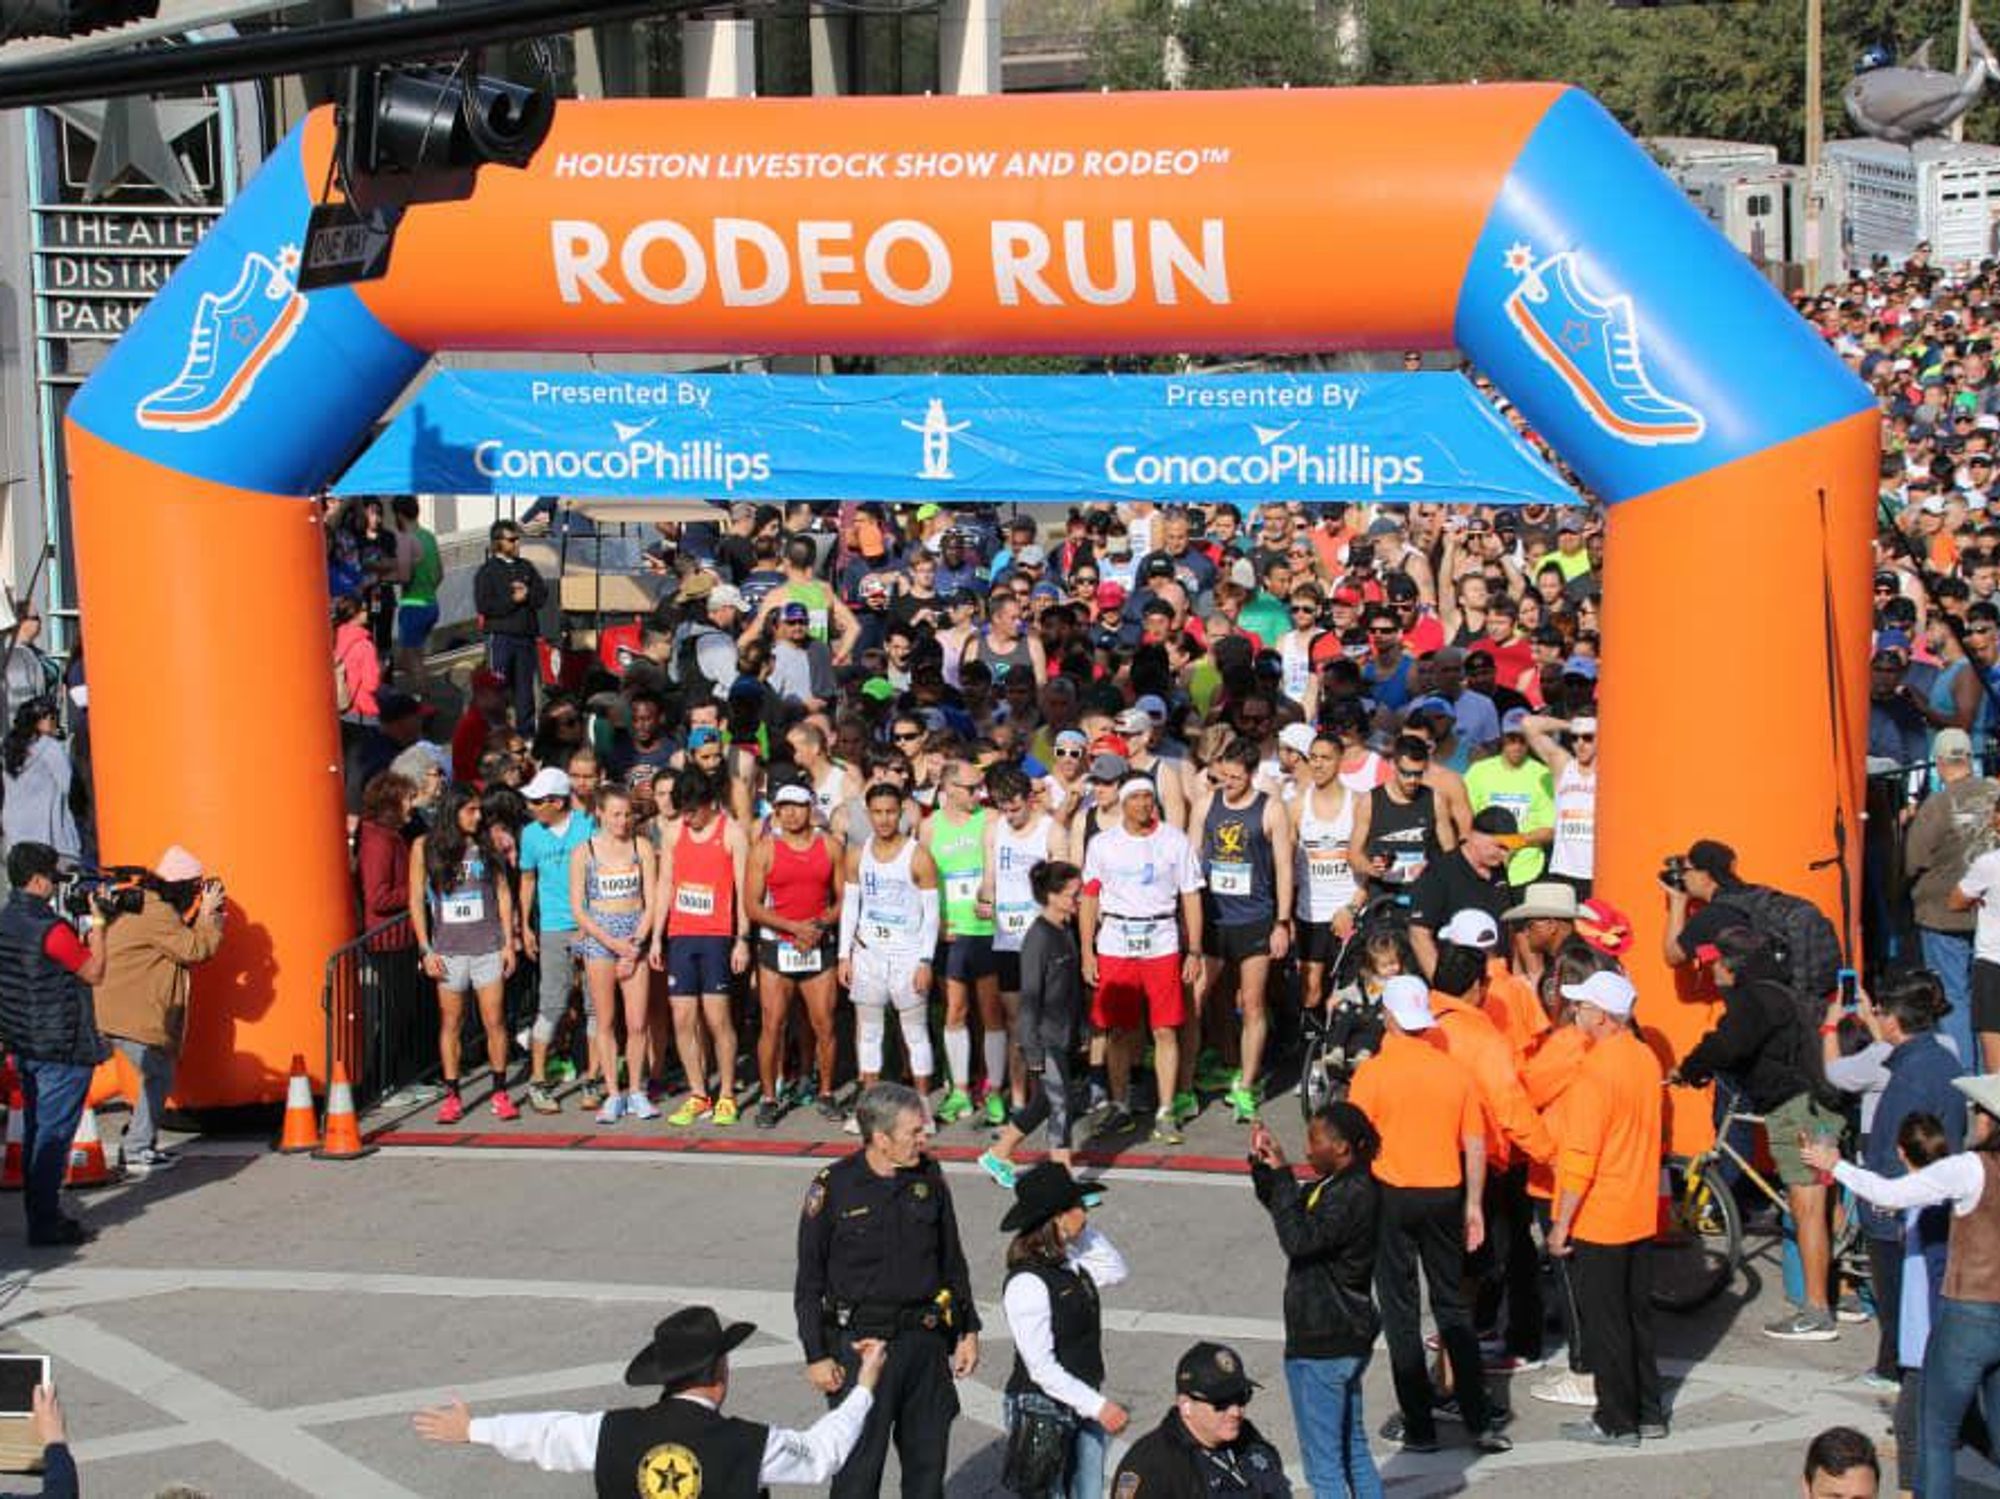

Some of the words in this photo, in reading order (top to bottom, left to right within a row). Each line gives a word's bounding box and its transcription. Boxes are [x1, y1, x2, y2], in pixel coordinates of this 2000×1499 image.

[555, 153, 711, 179] HOUSTON
[716, 152, 888, 179] LIVESTOCK
[894, 151, 999, 178] SHOW
[1002, 150, 1076, 177] AND
[551, 217, 953, 307] RODEO
[990, 218, 1230, 305] RUN
[532, 381, 668, 405] Presented
[677, 381, 710, 409] By
[1167, 383, 1314, 407] Presented
[1322, 383, 1360, 410] By
[475, 440, 771, 491] ConocoPhillips
[1105, 443, 1424, 494] ConocoPhillips
